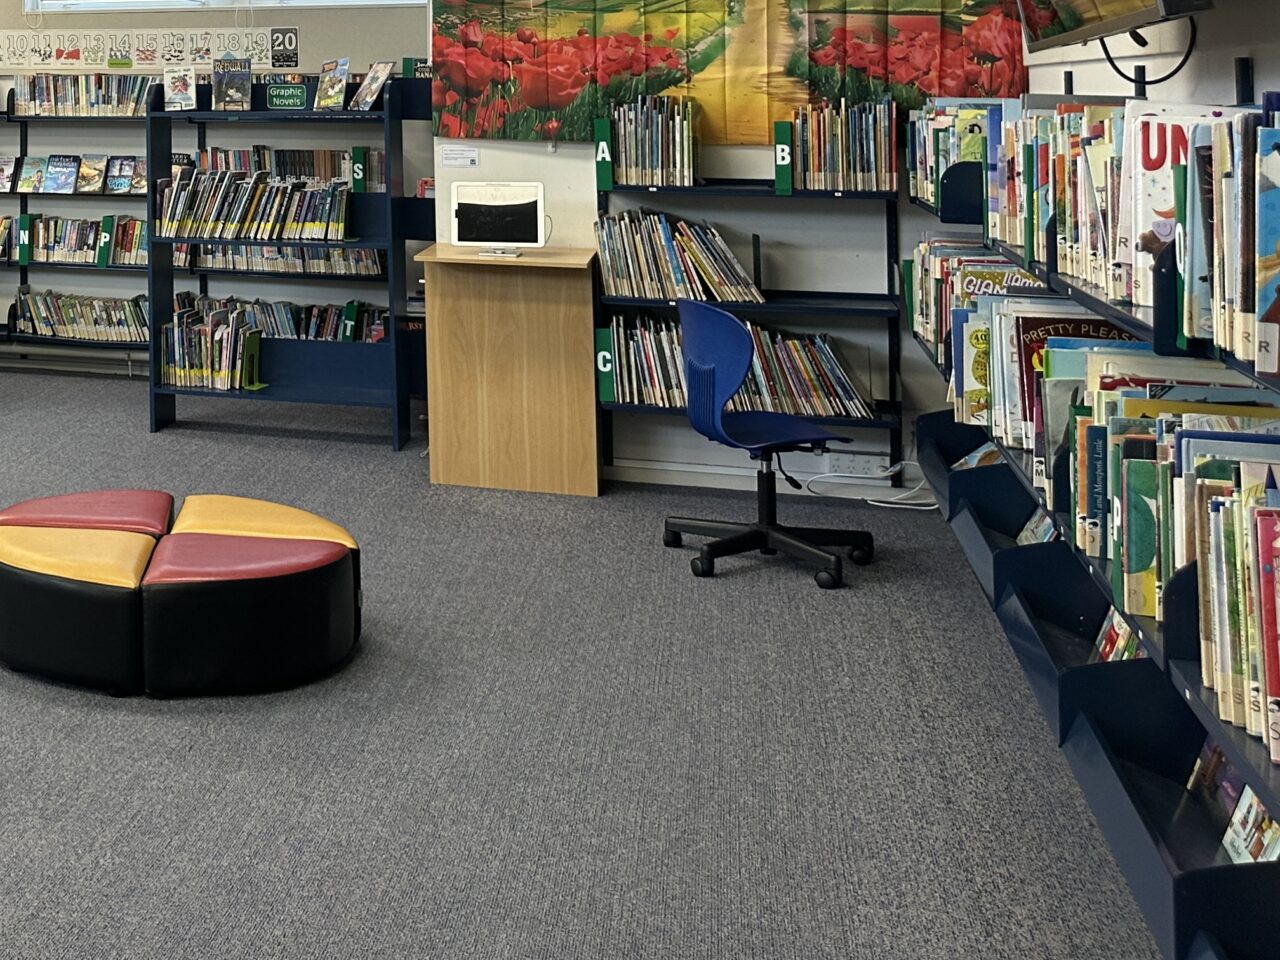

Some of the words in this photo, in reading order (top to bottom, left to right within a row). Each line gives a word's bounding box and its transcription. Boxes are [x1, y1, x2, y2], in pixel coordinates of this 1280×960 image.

[6, 34, 28, 52] 10
[31, 34, 52, 51] 11
[57, 34, 79, 51] 12
[83, 34, 105, 51] 13
[109, 34, 131, 51] 14
[135, 33, 158, 50] 15
[162, 33, 185, 52] 16
[189, 33, 212, 51] 17
[216, 33, 240, 51] 18
[244, 32, 269, 50] 19
[272, 32, 297, 50] 20
[214, 61, 250, 73] REDWALL
[270, 87, 302, 98] Graphic
[273, 97, 301, 106] Novels
[596, 141, 611, 162] A
[776, 143, 791, 166] B
[353, 163, 363, 179] S
[20, 229, 29, 245] N
[100, 231, 110, 247] P
[1119, 236, 1129, 248] R
[1112, 273, 1122, 282] M
[1133, 280, 1141, 289] S
[344, 320, 354, 336] T
[1023, 323, 1074, 344] PRETTY
[1259, 340, 1270, 354] R
[597, 351, 612, 373] C
[1035, 469, 1043, 477] M
[1251, 700, 1261, 712] S
